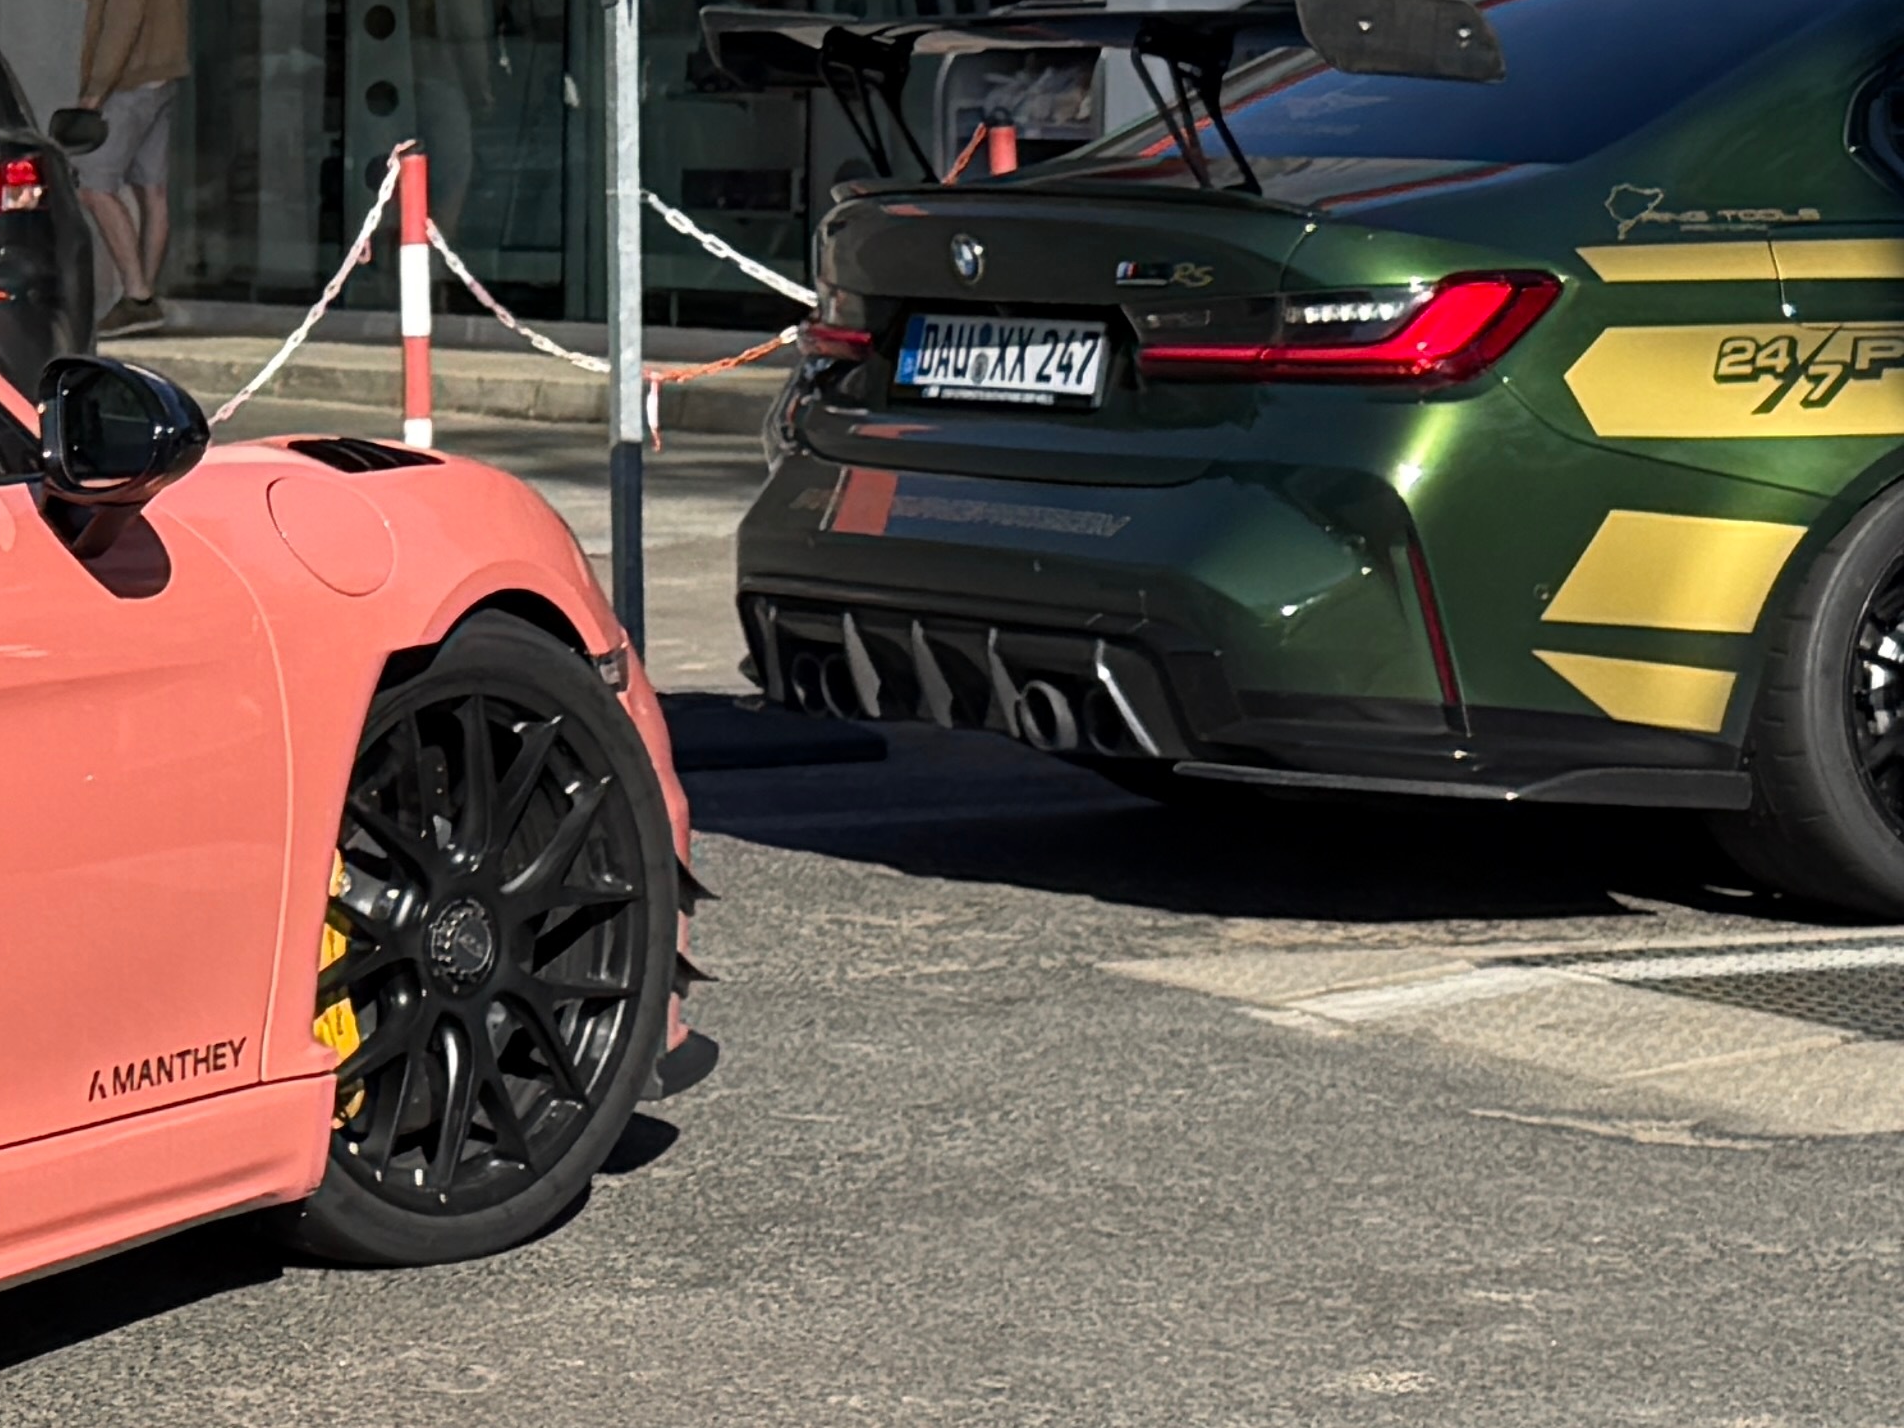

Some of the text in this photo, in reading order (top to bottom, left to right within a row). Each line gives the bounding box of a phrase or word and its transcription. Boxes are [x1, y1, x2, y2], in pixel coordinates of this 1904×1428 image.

[918, 322, 1101, 387] DAU XX 247
[112, 1035, 248, 1097] MANTHEY
